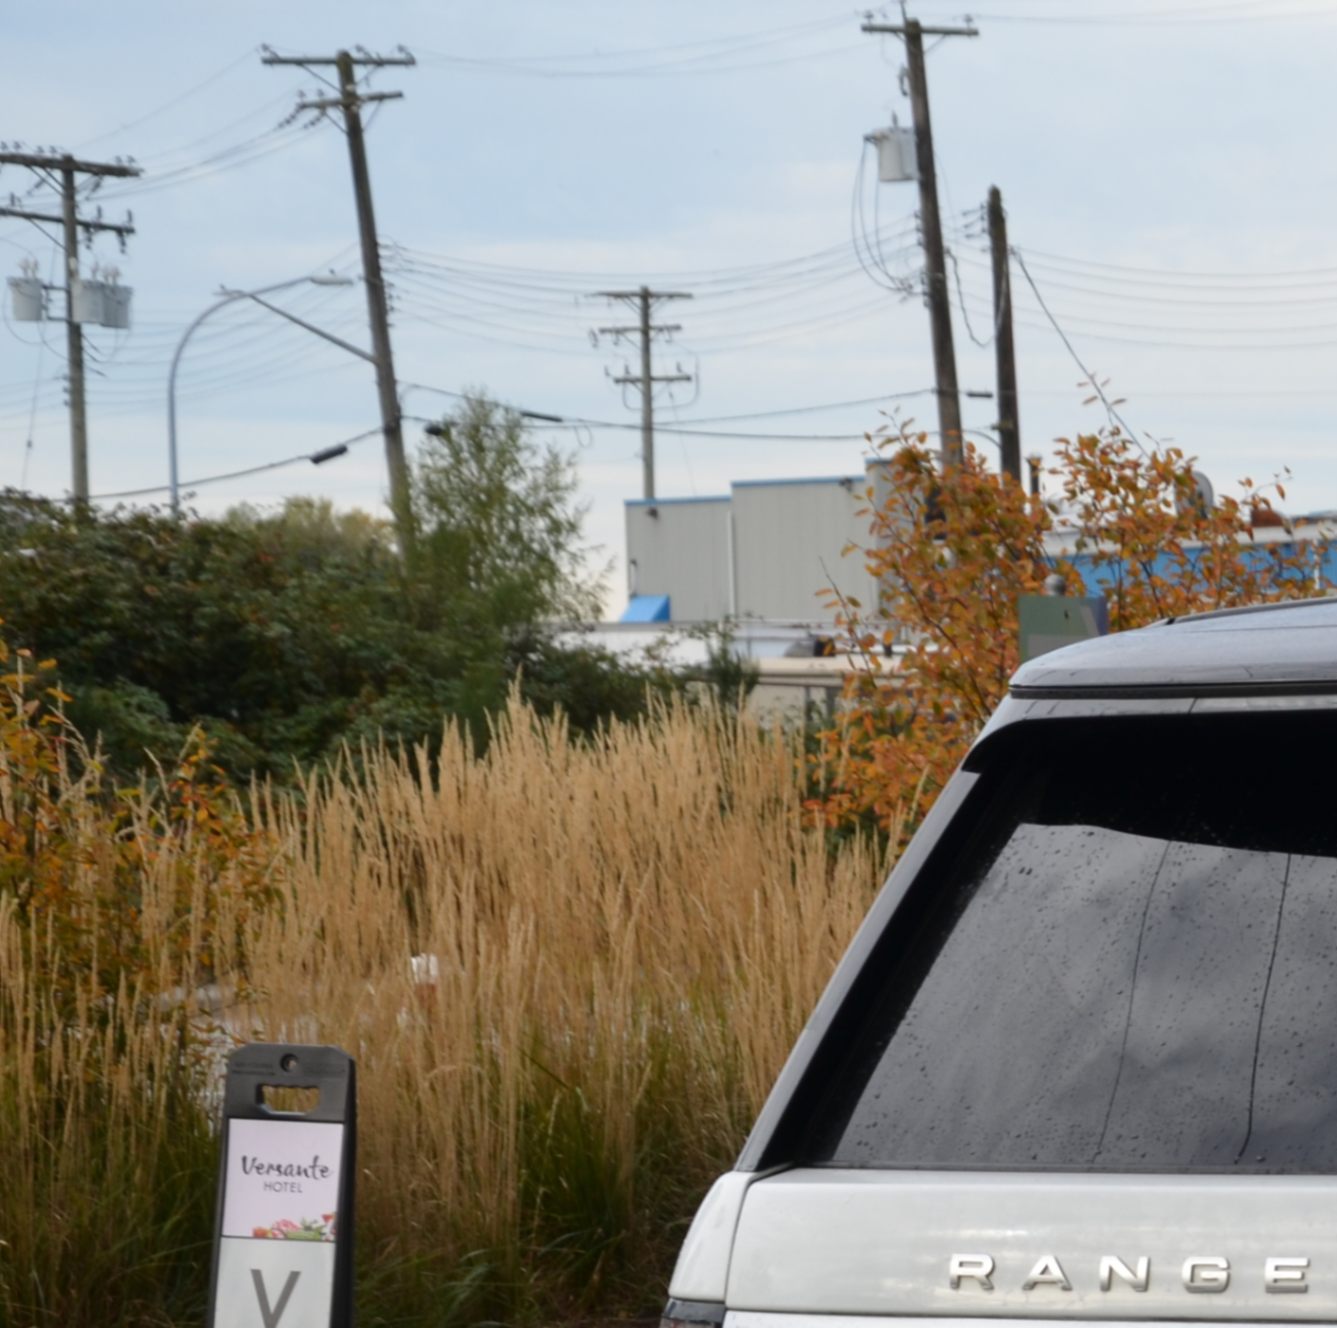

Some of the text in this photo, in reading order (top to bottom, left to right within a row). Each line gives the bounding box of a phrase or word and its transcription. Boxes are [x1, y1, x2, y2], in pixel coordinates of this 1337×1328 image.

[241, 1155, 334, 1180] Versante
[263, 1181, 303, 1193] HOTEL
[949, 1253, 1311, 1294] RANGE
